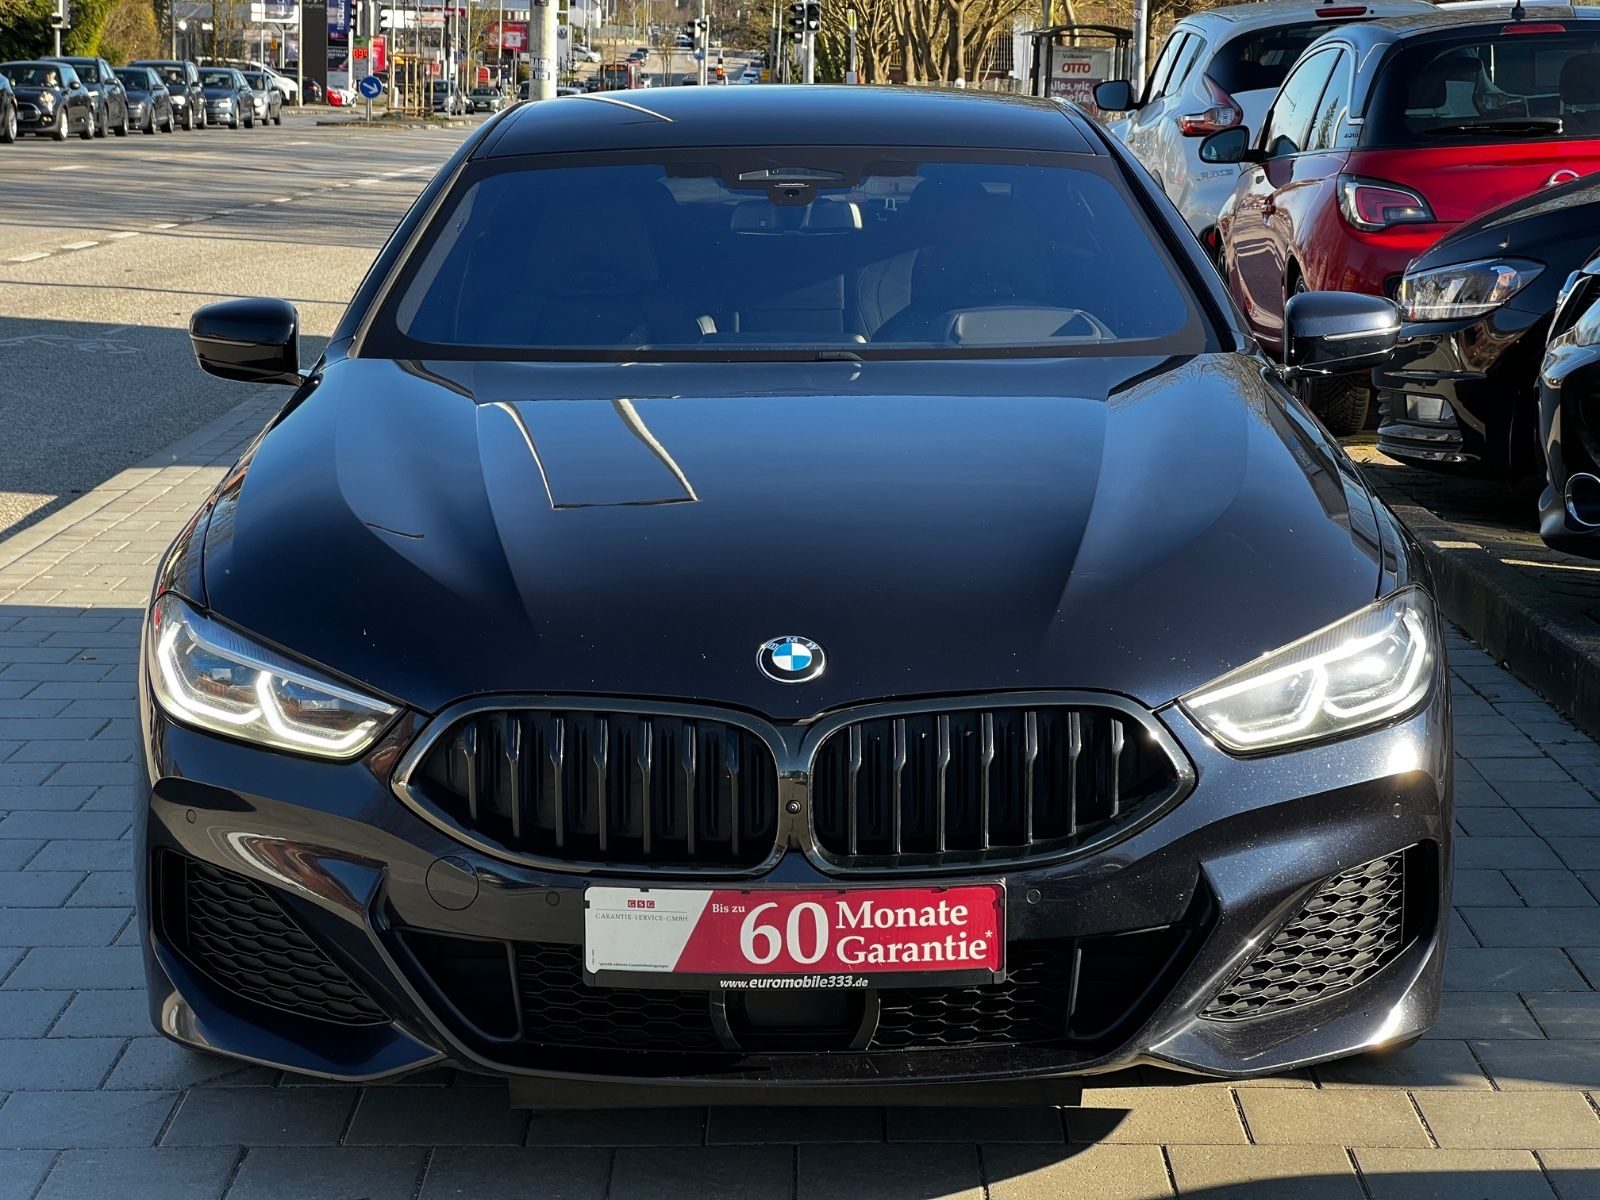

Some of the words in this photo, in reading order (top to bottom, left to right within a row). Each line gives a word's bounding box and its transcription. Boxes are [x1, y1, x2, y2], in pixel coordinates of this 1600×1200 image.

[1062, 63, 1091, 73] OTTO
[835, 900, 969, 929] Monate
[712, 903, 729, 913] Bis
[731, 904, 745, 913] zu
[740, 901, 829, 965] 60
[719, 975, 869, 989] www.euromobile333.de
